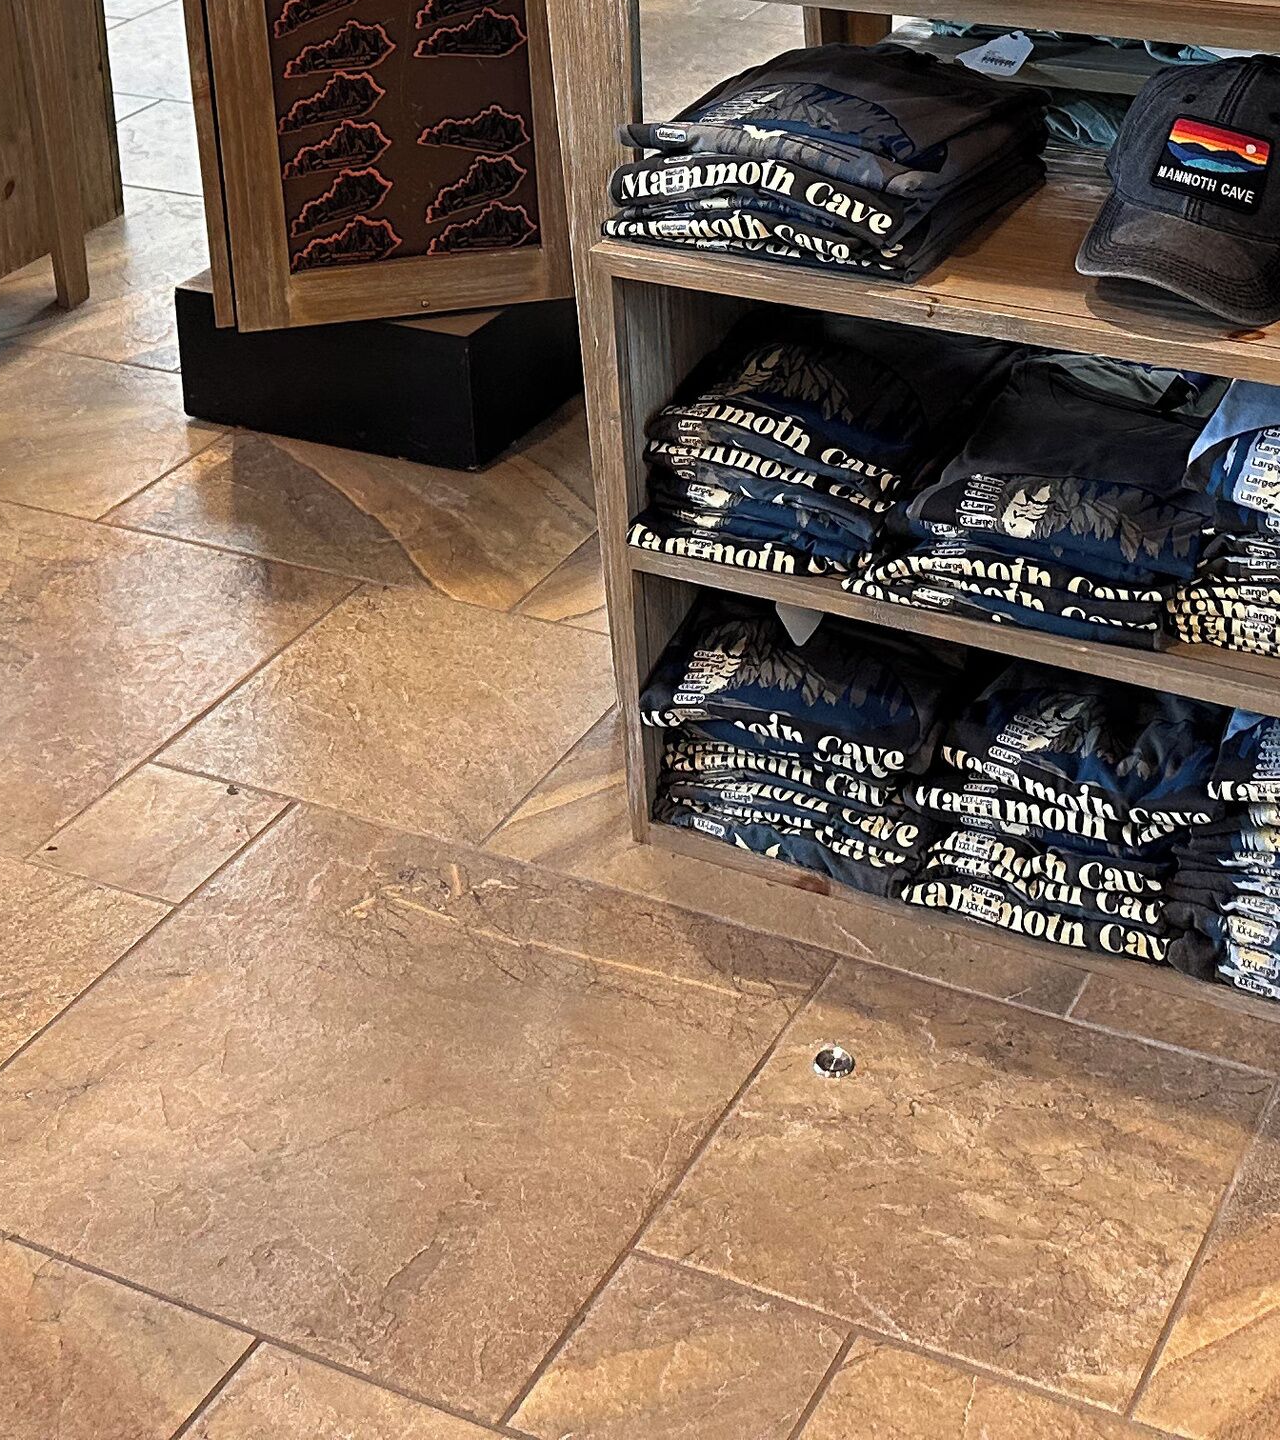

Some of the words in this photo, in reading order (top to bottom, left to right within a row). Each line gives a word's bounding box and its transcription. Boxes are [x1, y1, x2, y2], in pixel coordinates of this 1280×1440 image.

[1157, 165, 1217, 192] MAMMOTH
[1221, 183, 1255, 204] CAVE
[804, 181, 894, 236] Cave
[1252, 459, 1280, 471] Large
[1246, 475, 1275, 488] Large
[1241, 491, 1268, 505] Large
[962, 517, 994, 528] X-Large
[1239, 586, 1268, 597] Large
[1246, 611, 1276, 624] Large
[971, 884, 1004, 902] XXX-Large
[1236, 924, 1271, 944] XX-Large
[1098, 923, 1171, 962] Cav
[1238, 977, 1273, 995] XX-Large
